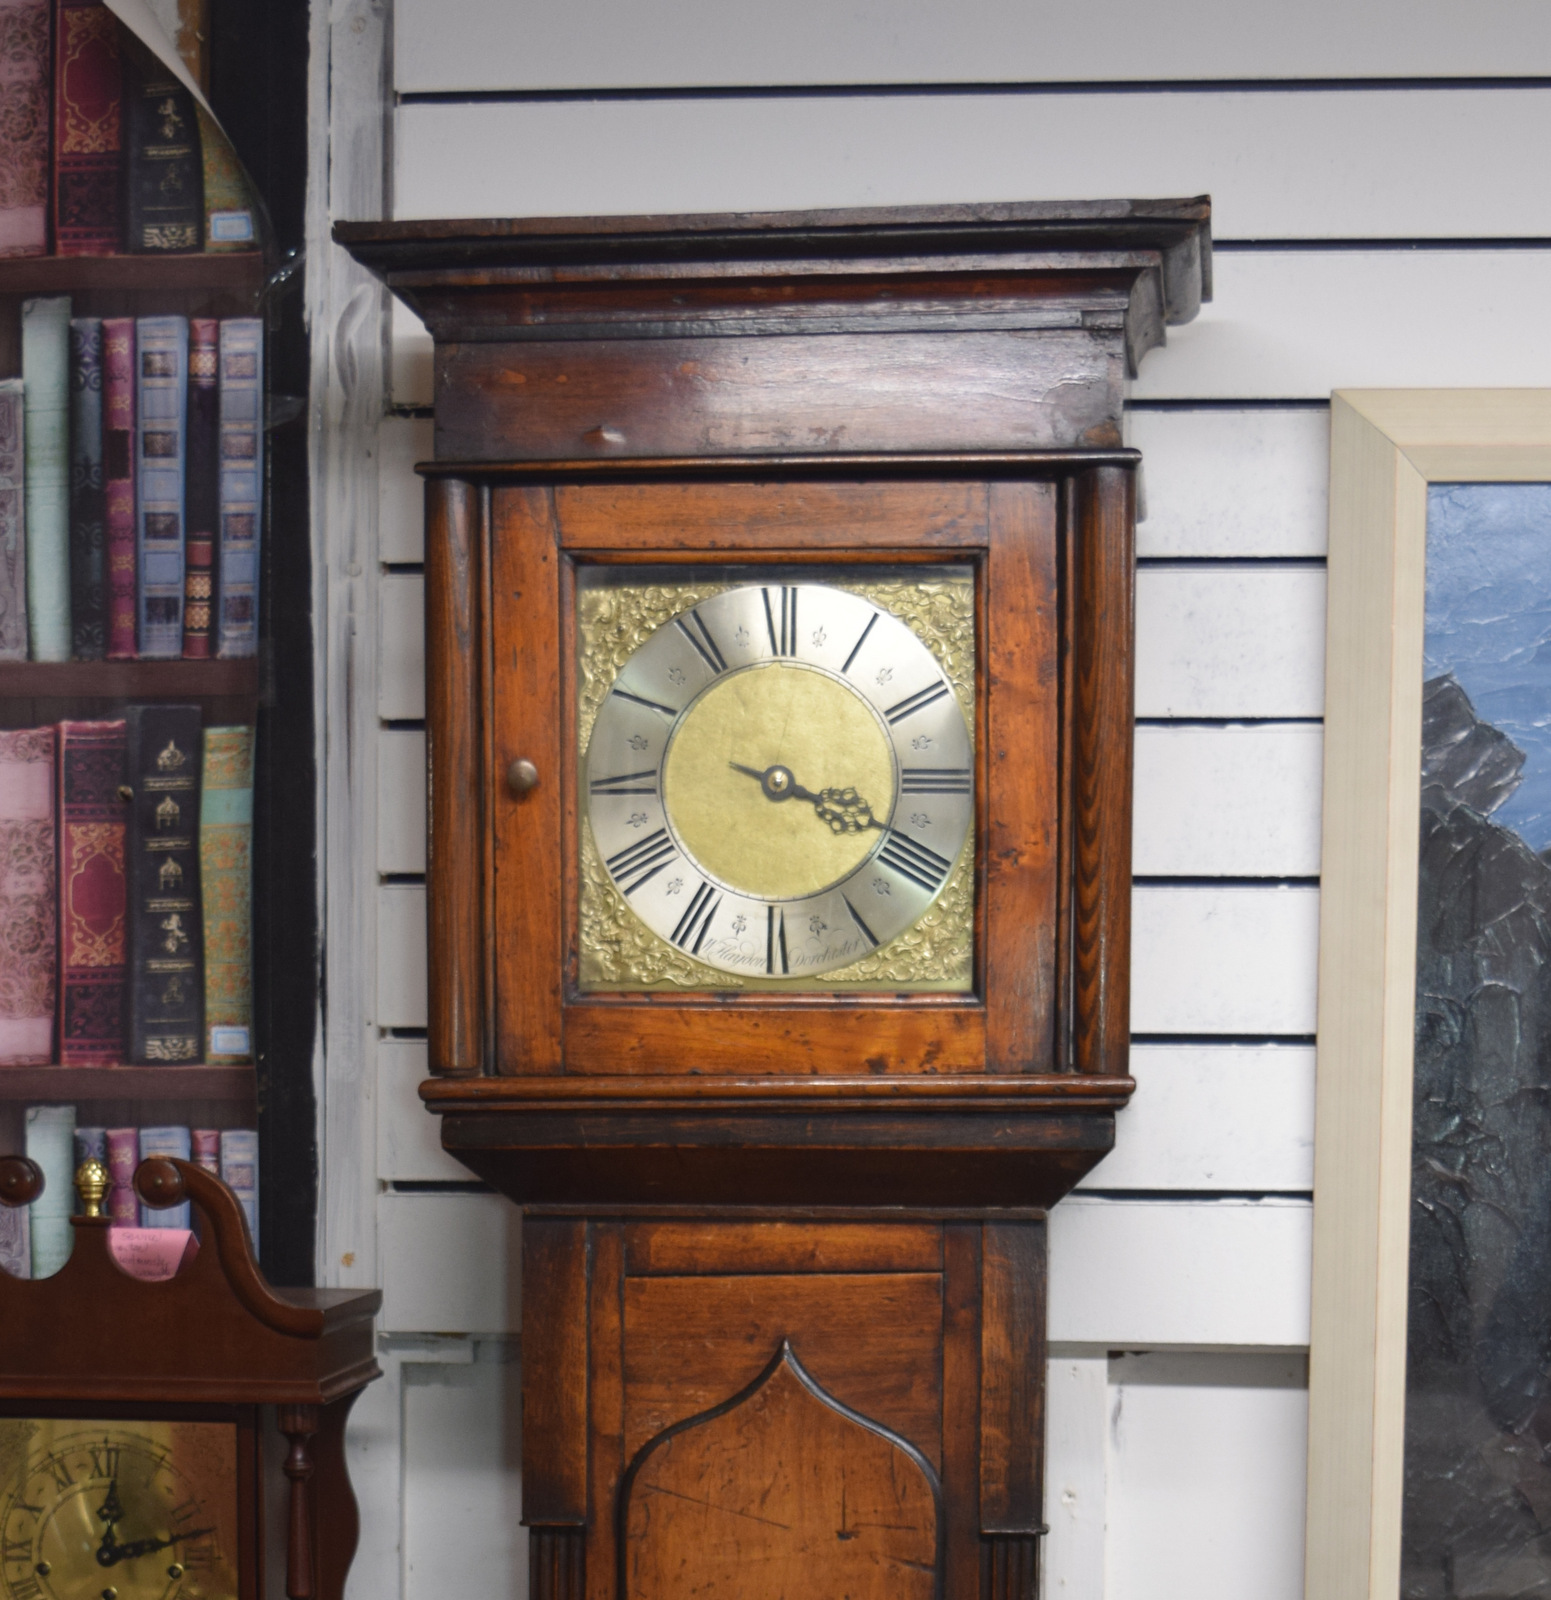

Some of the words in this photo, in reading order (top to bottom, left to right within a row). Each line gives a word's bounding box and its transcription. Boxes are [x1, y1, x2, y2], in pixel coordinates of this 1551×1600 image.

[675, 609, 728, 675] XI
[761, 586, 798, 657] XII
[842, 612, 880, 674] I
[612, 680, 677, 728] X
[884, 680, 950, 725] II
[590, 769, 657, 796] IX
[901, 768, 970, 794] III
[606, 828, 677, 896] VIII
[877, 828, 952, 894] IIII
[670, 882, 723, 955] VII
[764, 904, 790, 975] VI
[840, 890, 886, 954] V
